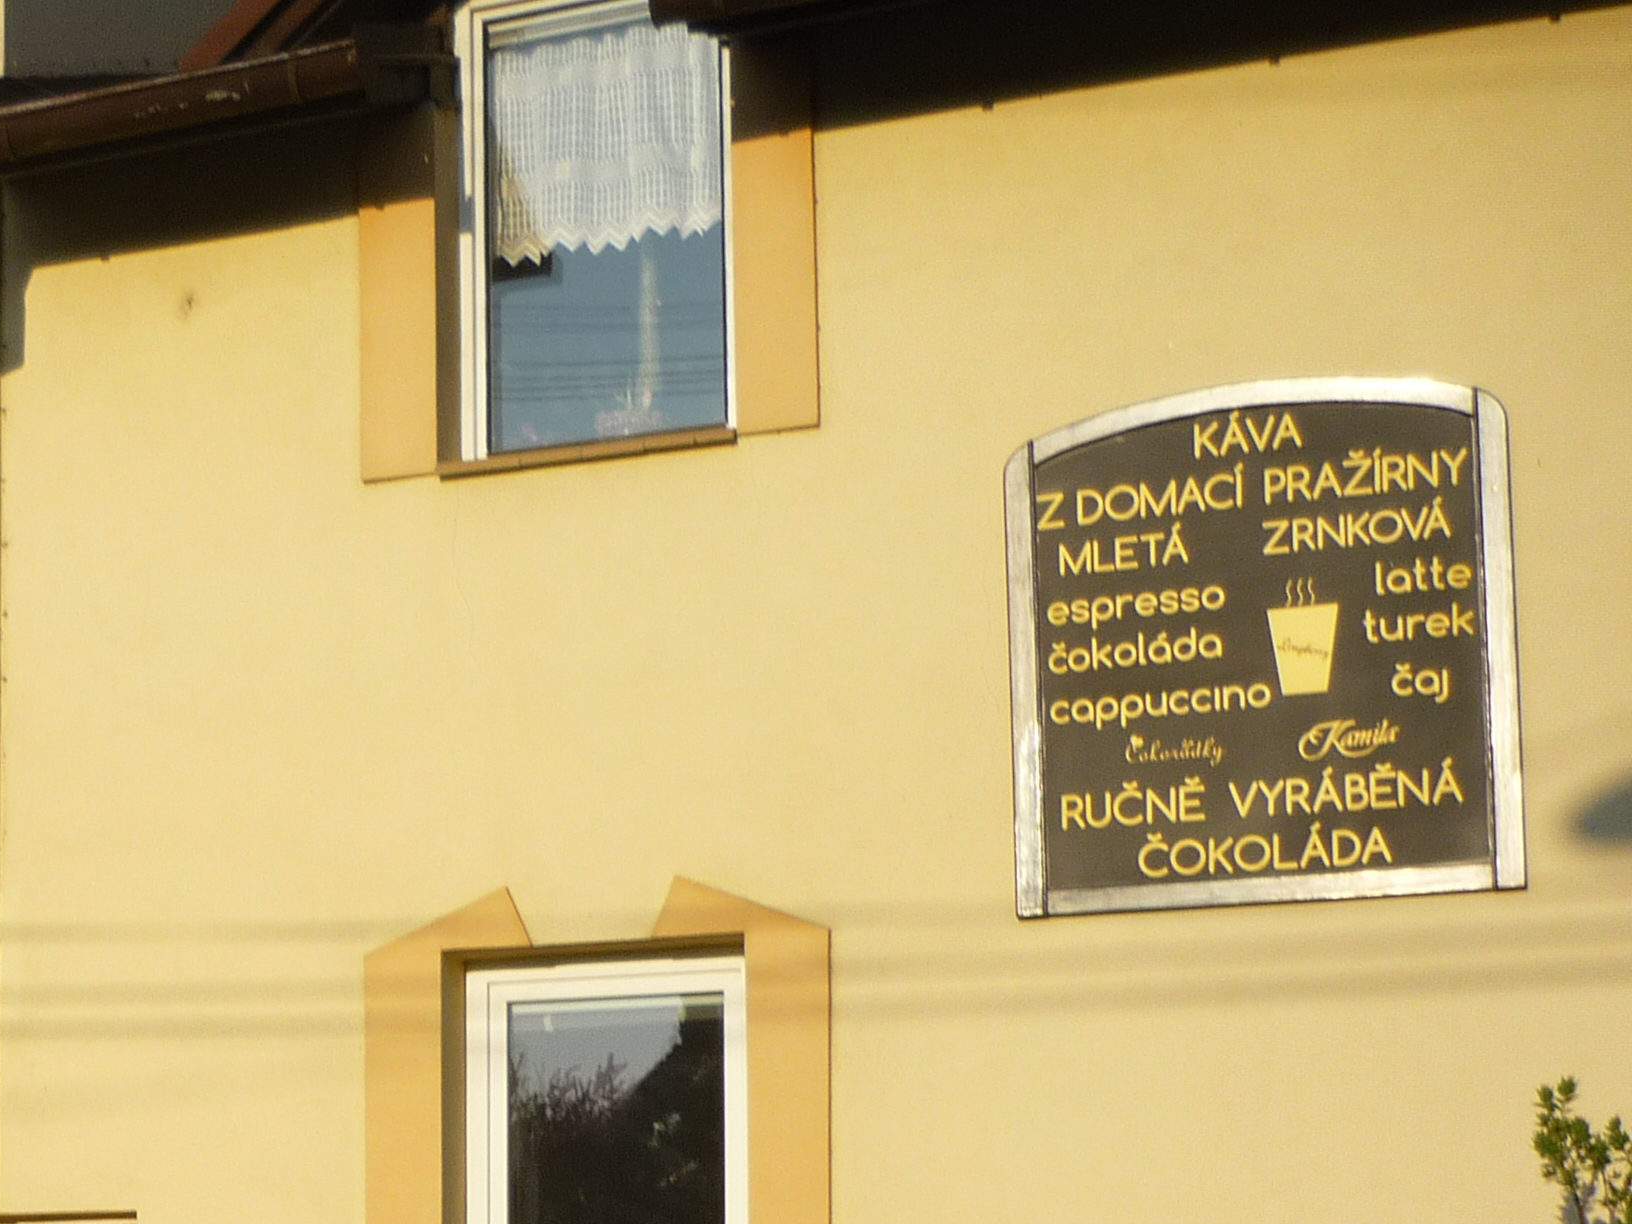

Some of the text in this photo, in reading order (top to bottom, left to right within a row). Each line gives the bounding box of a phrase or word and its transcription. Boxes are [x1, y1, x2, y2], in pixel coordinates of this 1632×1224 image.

[1192, 410, 1302, 458] KÁVA
[1036, 447, 1468, 531] Z DOMACÍ PRAŽÍRNY
[1057, 496, 1451, 576] MLETÁ ZRNKOVÁ
[1374, 557, 1472, 595] latte
[1046, 585, 1225, 629] espresso
[1362, 603, 1475, 643] turek
[1047, 630, 1222, 675] čokoláda
[1049, 681, 1271, 729] cappuccino
[1390, 664, 1450, 703] čaj
[1060, 757, 1463, 831] RUČNĚ VYRÁBĚNÁ
[1137, 821, 1392, 877] ČOKOLÁDA
